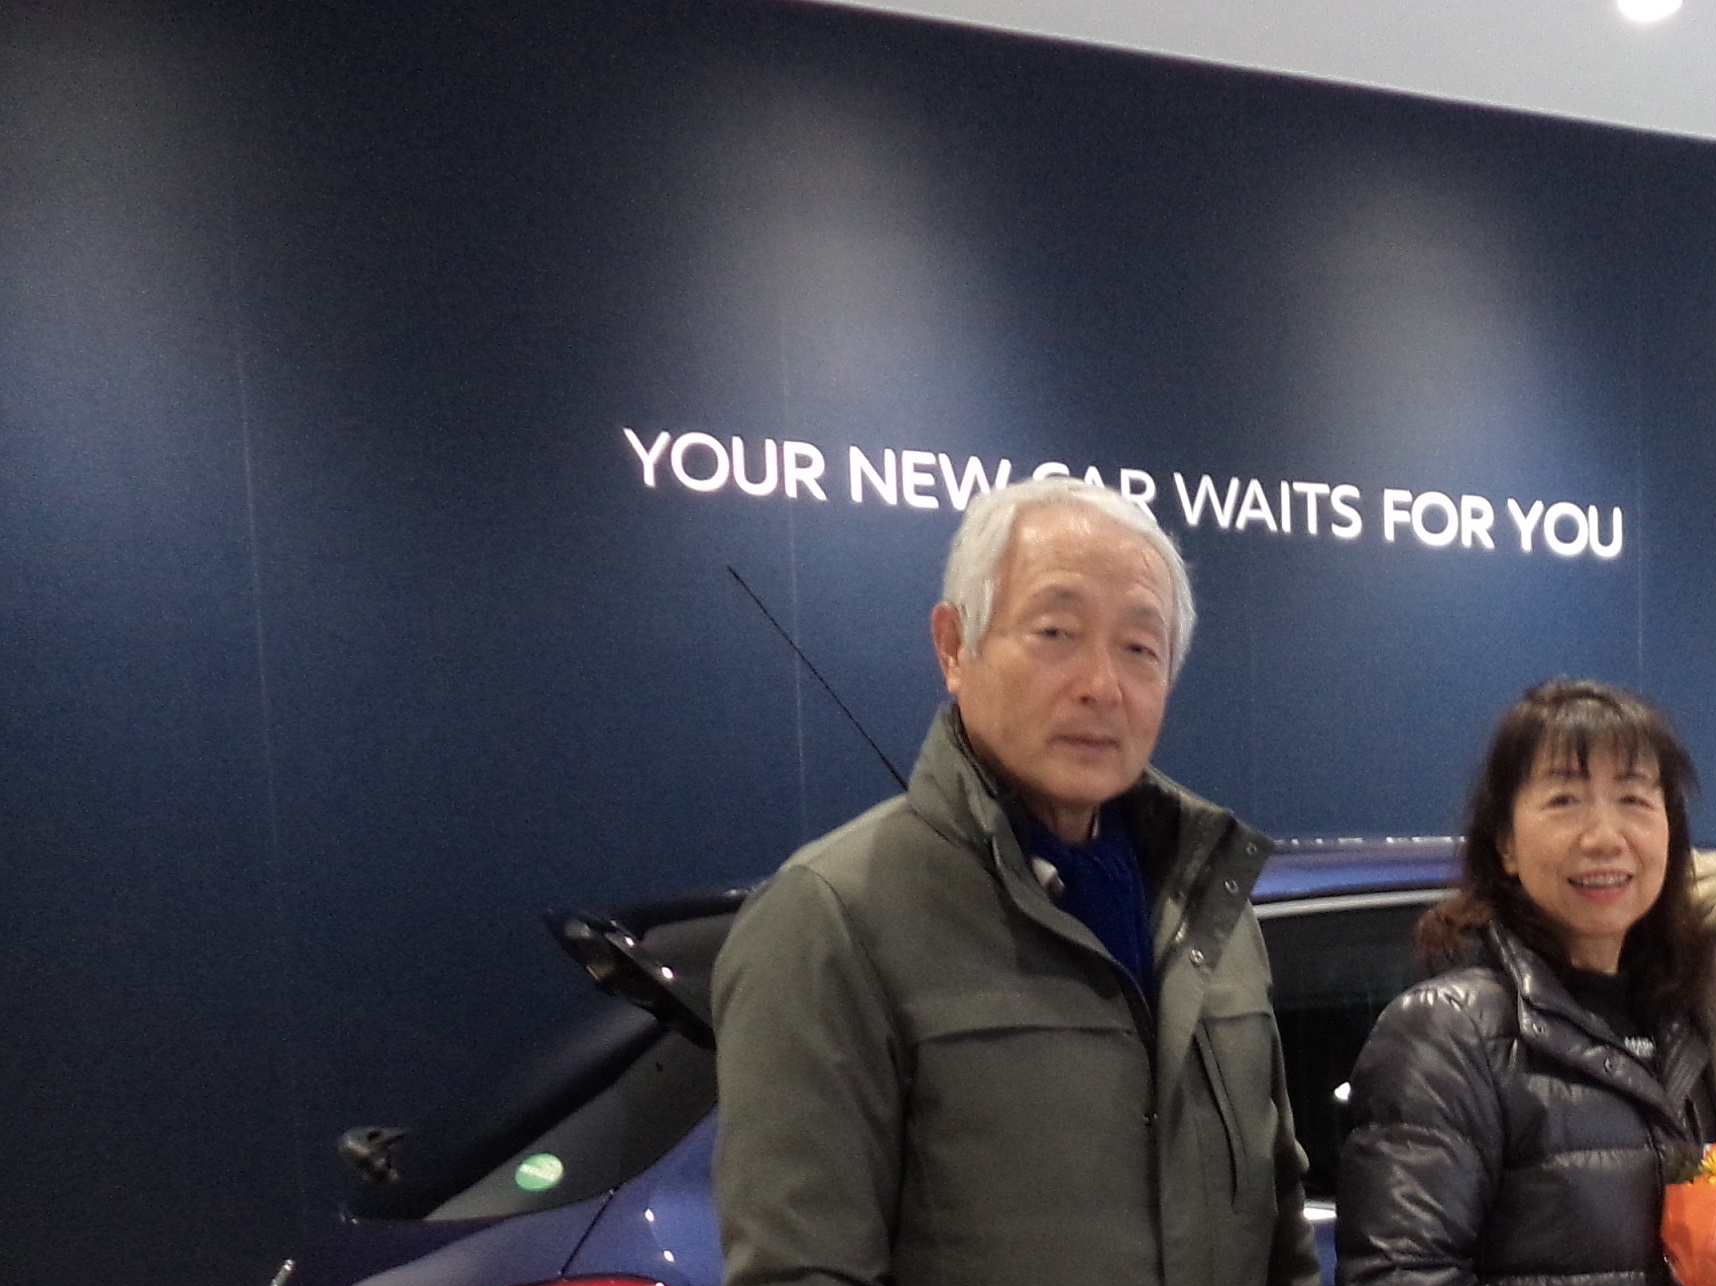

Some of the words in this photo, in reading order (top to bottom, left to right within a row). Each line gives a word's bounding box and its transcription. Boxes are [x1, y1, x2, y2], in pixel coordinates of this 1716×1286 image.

[623, 427, 828, 502] YOUR
[848, 445, 1013, 514] NEW
[1174, 472, 1364, 540] WAITS
[1382, 486, 1496, 550] FOR
[1506, 497, 1624, 559] YOU
